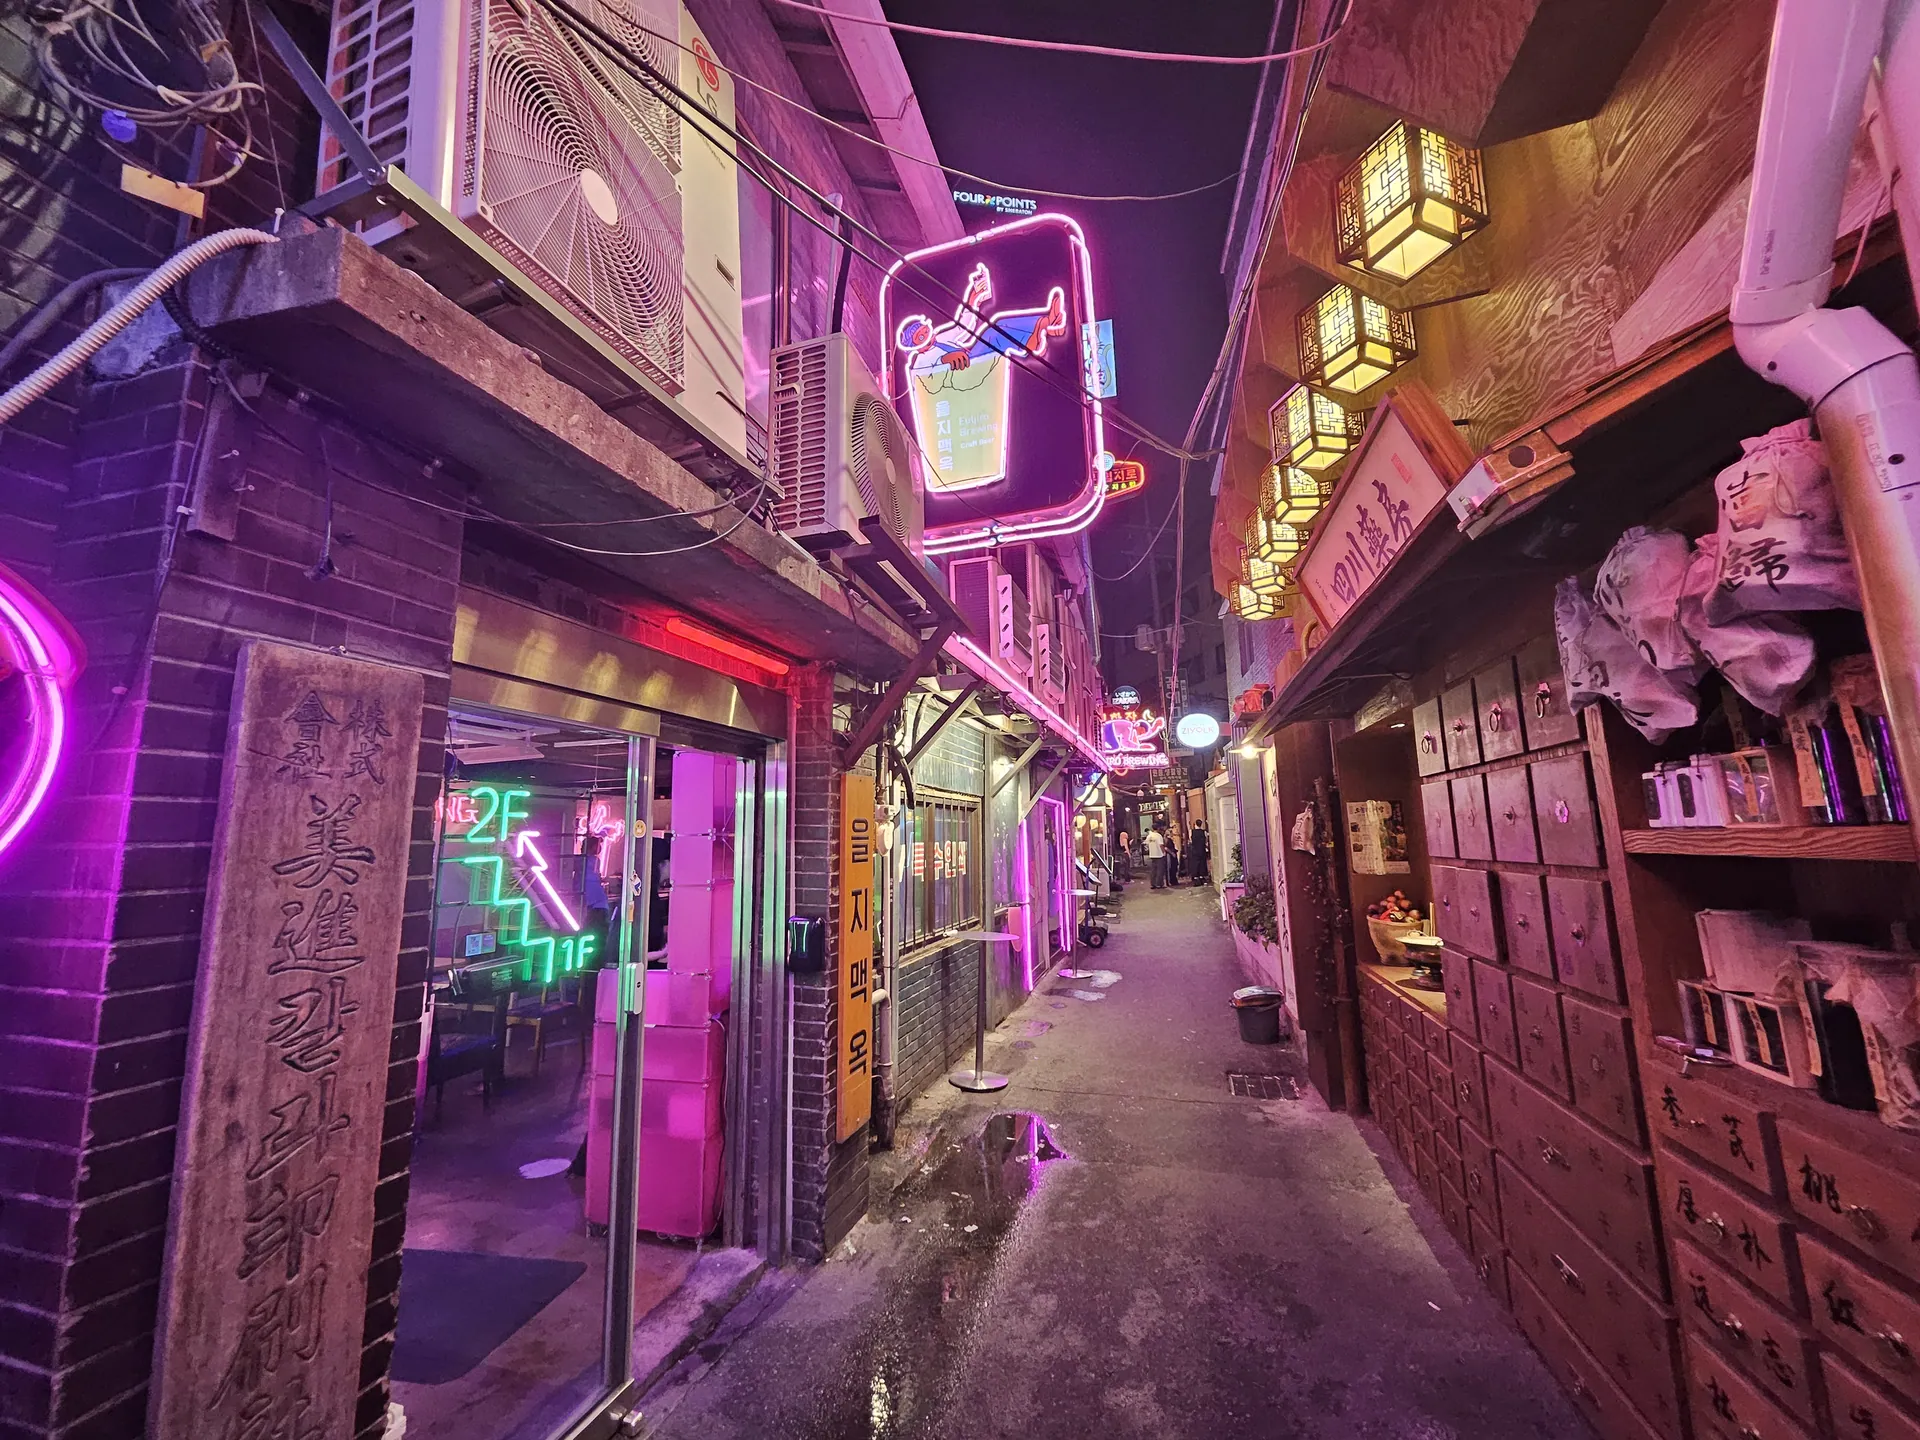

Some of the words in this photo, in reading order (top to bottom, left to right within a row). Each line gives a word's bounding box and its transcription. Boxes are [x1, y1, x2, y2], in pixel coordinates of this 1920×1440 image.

[696, 75, 718, 117] LG
[953, 191, 985, 204] FOUR
[996, 195, 1037, 210] POINTS
[1004, 207, 1033, 216] SHERATON
[466, 786, 531, 843] 2F
[561, 934, 596, 972] 1F
[848, 817, 870, 1076] 을지맥옥
